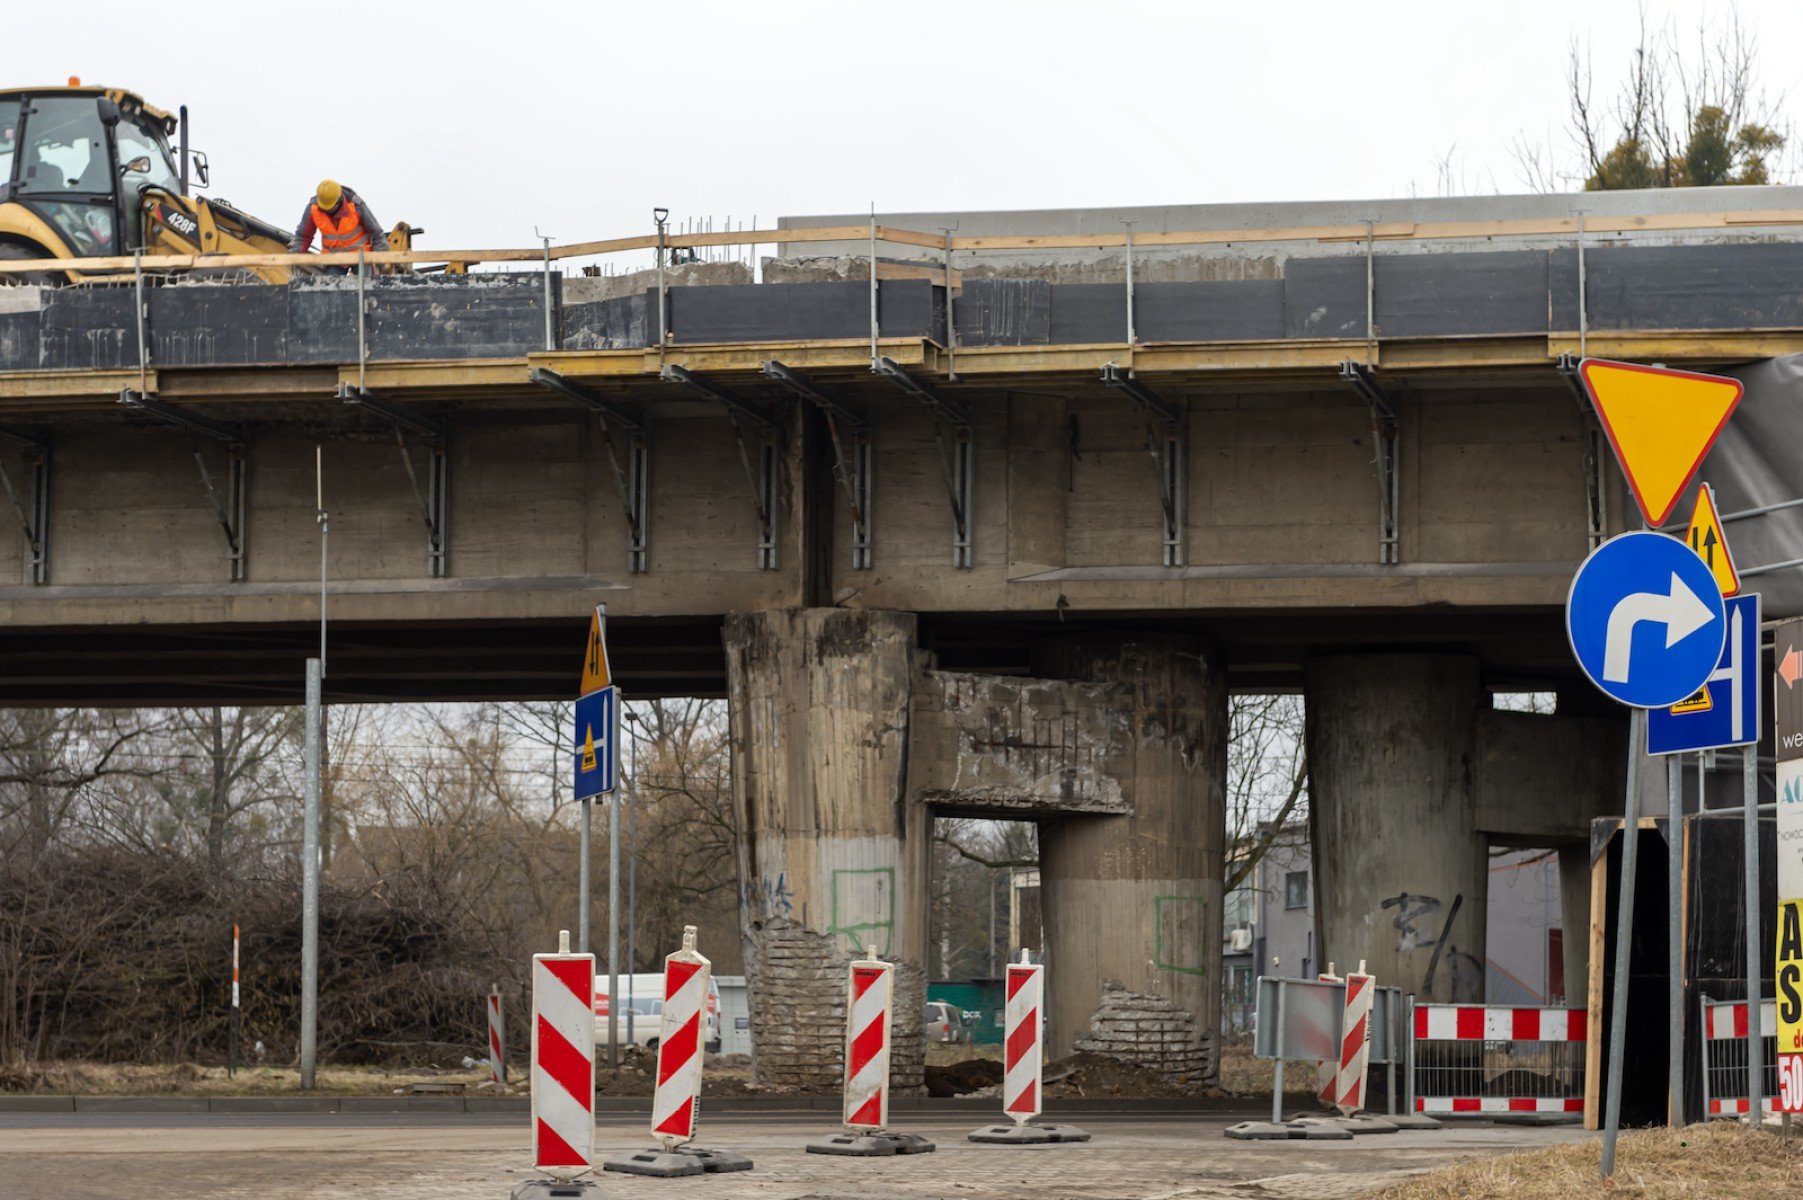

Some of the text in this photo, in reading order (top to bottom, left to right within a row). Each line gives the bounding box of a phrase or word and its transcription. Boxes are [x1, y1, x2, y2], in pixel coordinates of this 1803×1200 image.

[168, 212, 197, 234] 428F
[1779, 902, 1803, 960] A
[1780, 963, 1802, 1024] S
[1778, 1055, 1803, 1110] 50
